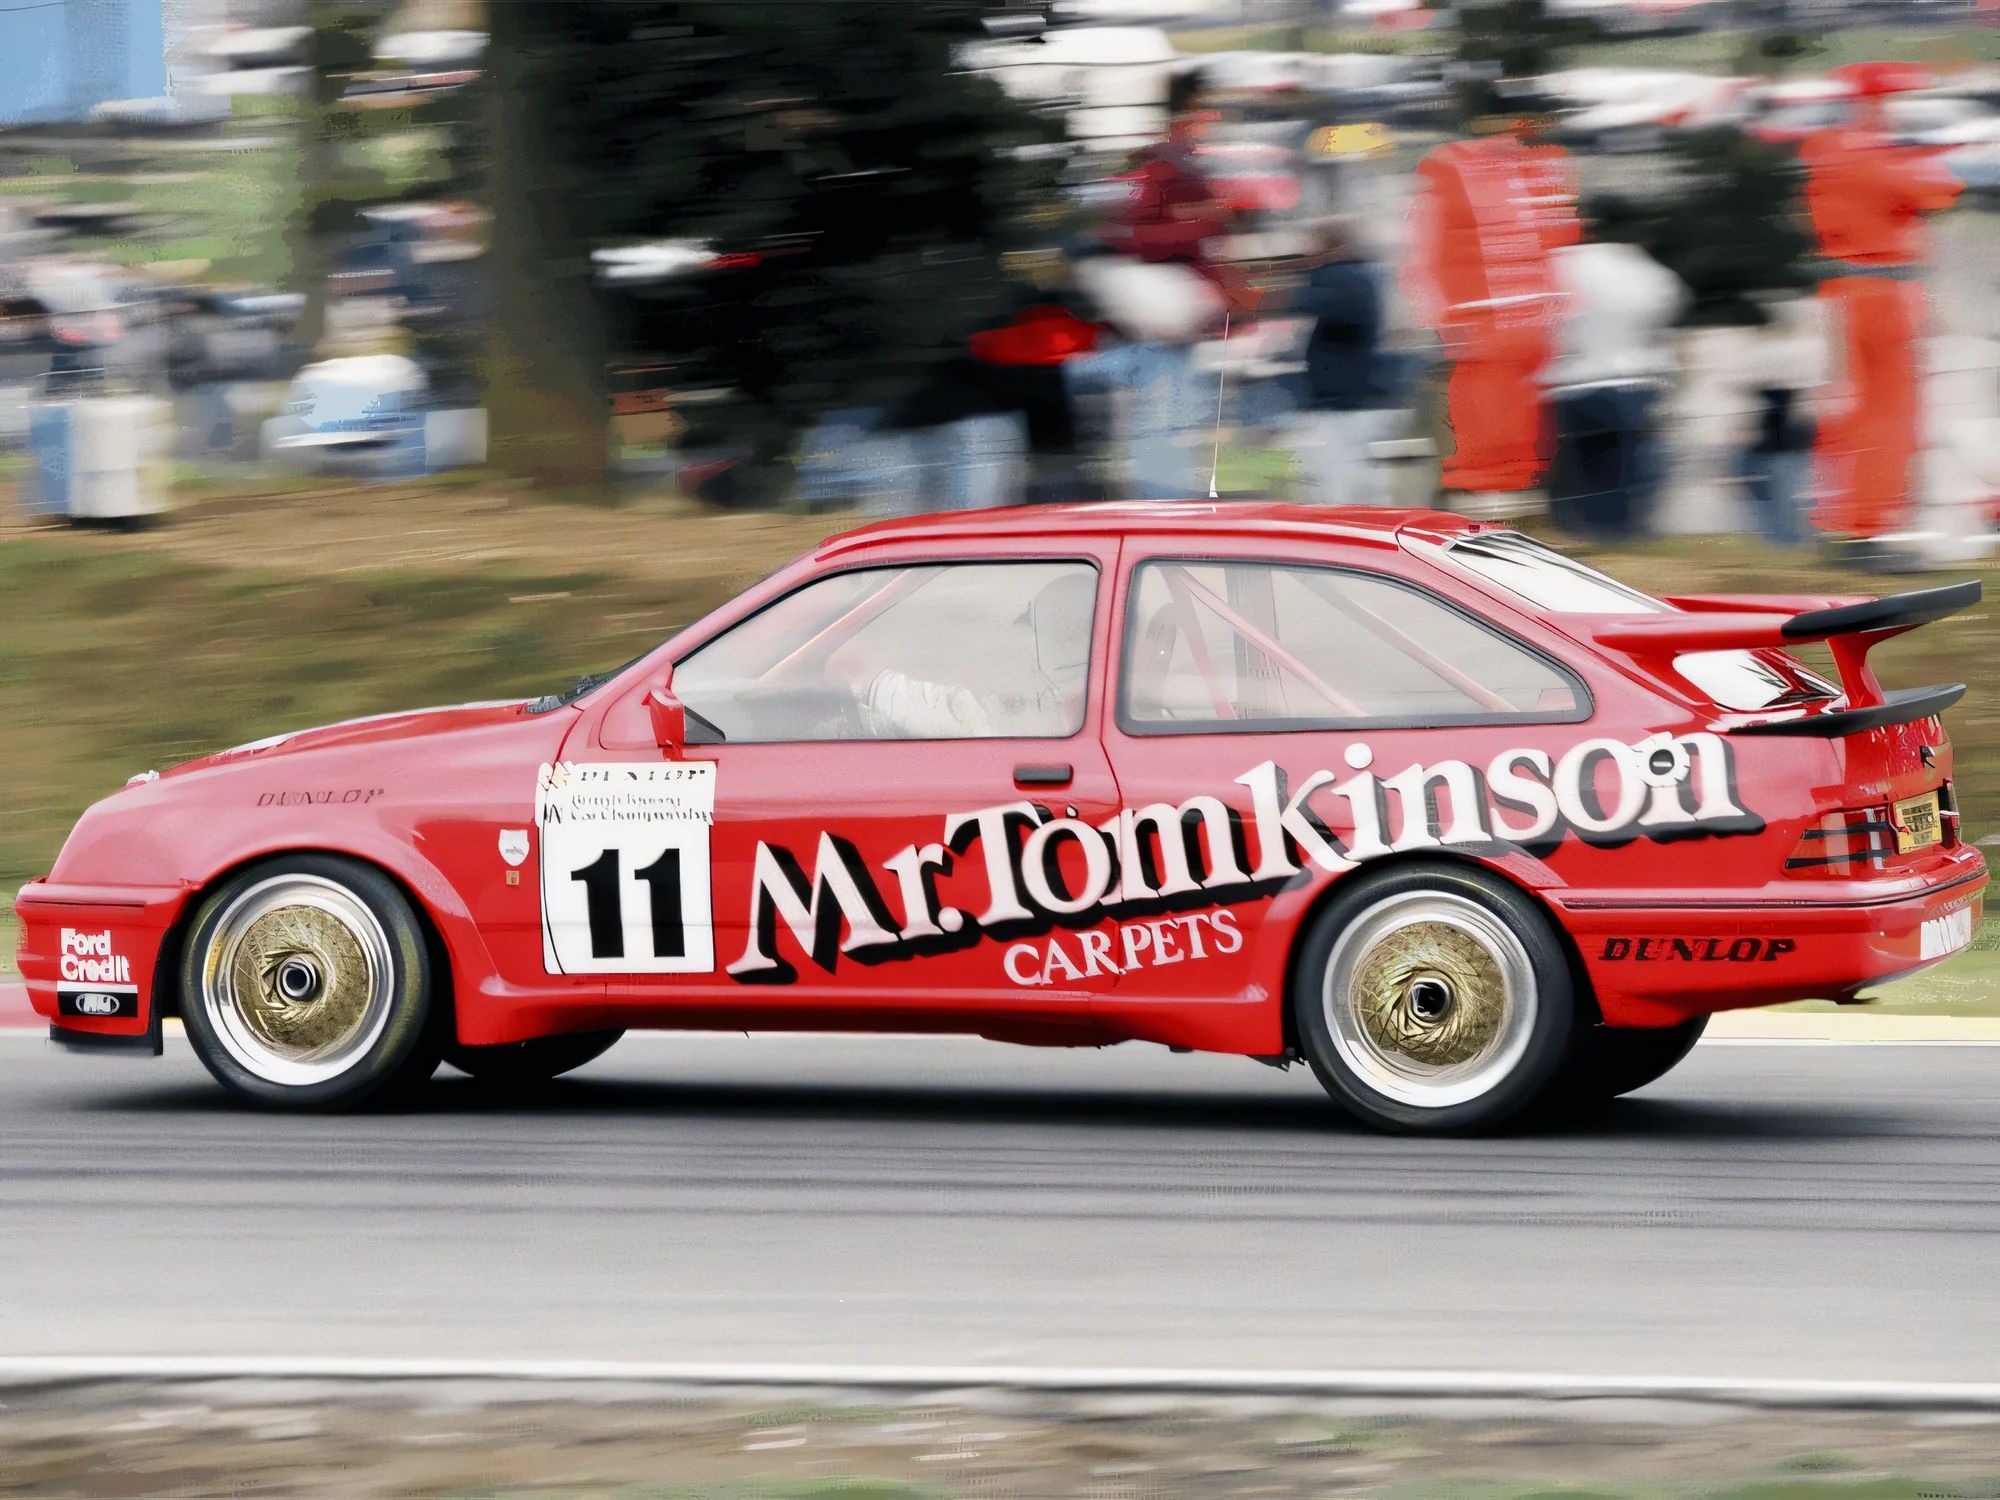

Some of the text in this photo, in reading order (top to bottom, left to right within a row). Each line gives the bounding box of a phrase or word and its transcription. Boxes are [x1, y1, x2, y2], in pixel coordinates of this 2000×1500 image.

[570, 848, 686, 959] 11
[61, 927, 111, 955] Ford
[1003, 908, 1245, 986] CARPETS
[1597, 937, 1797, 962] DUNLOP
